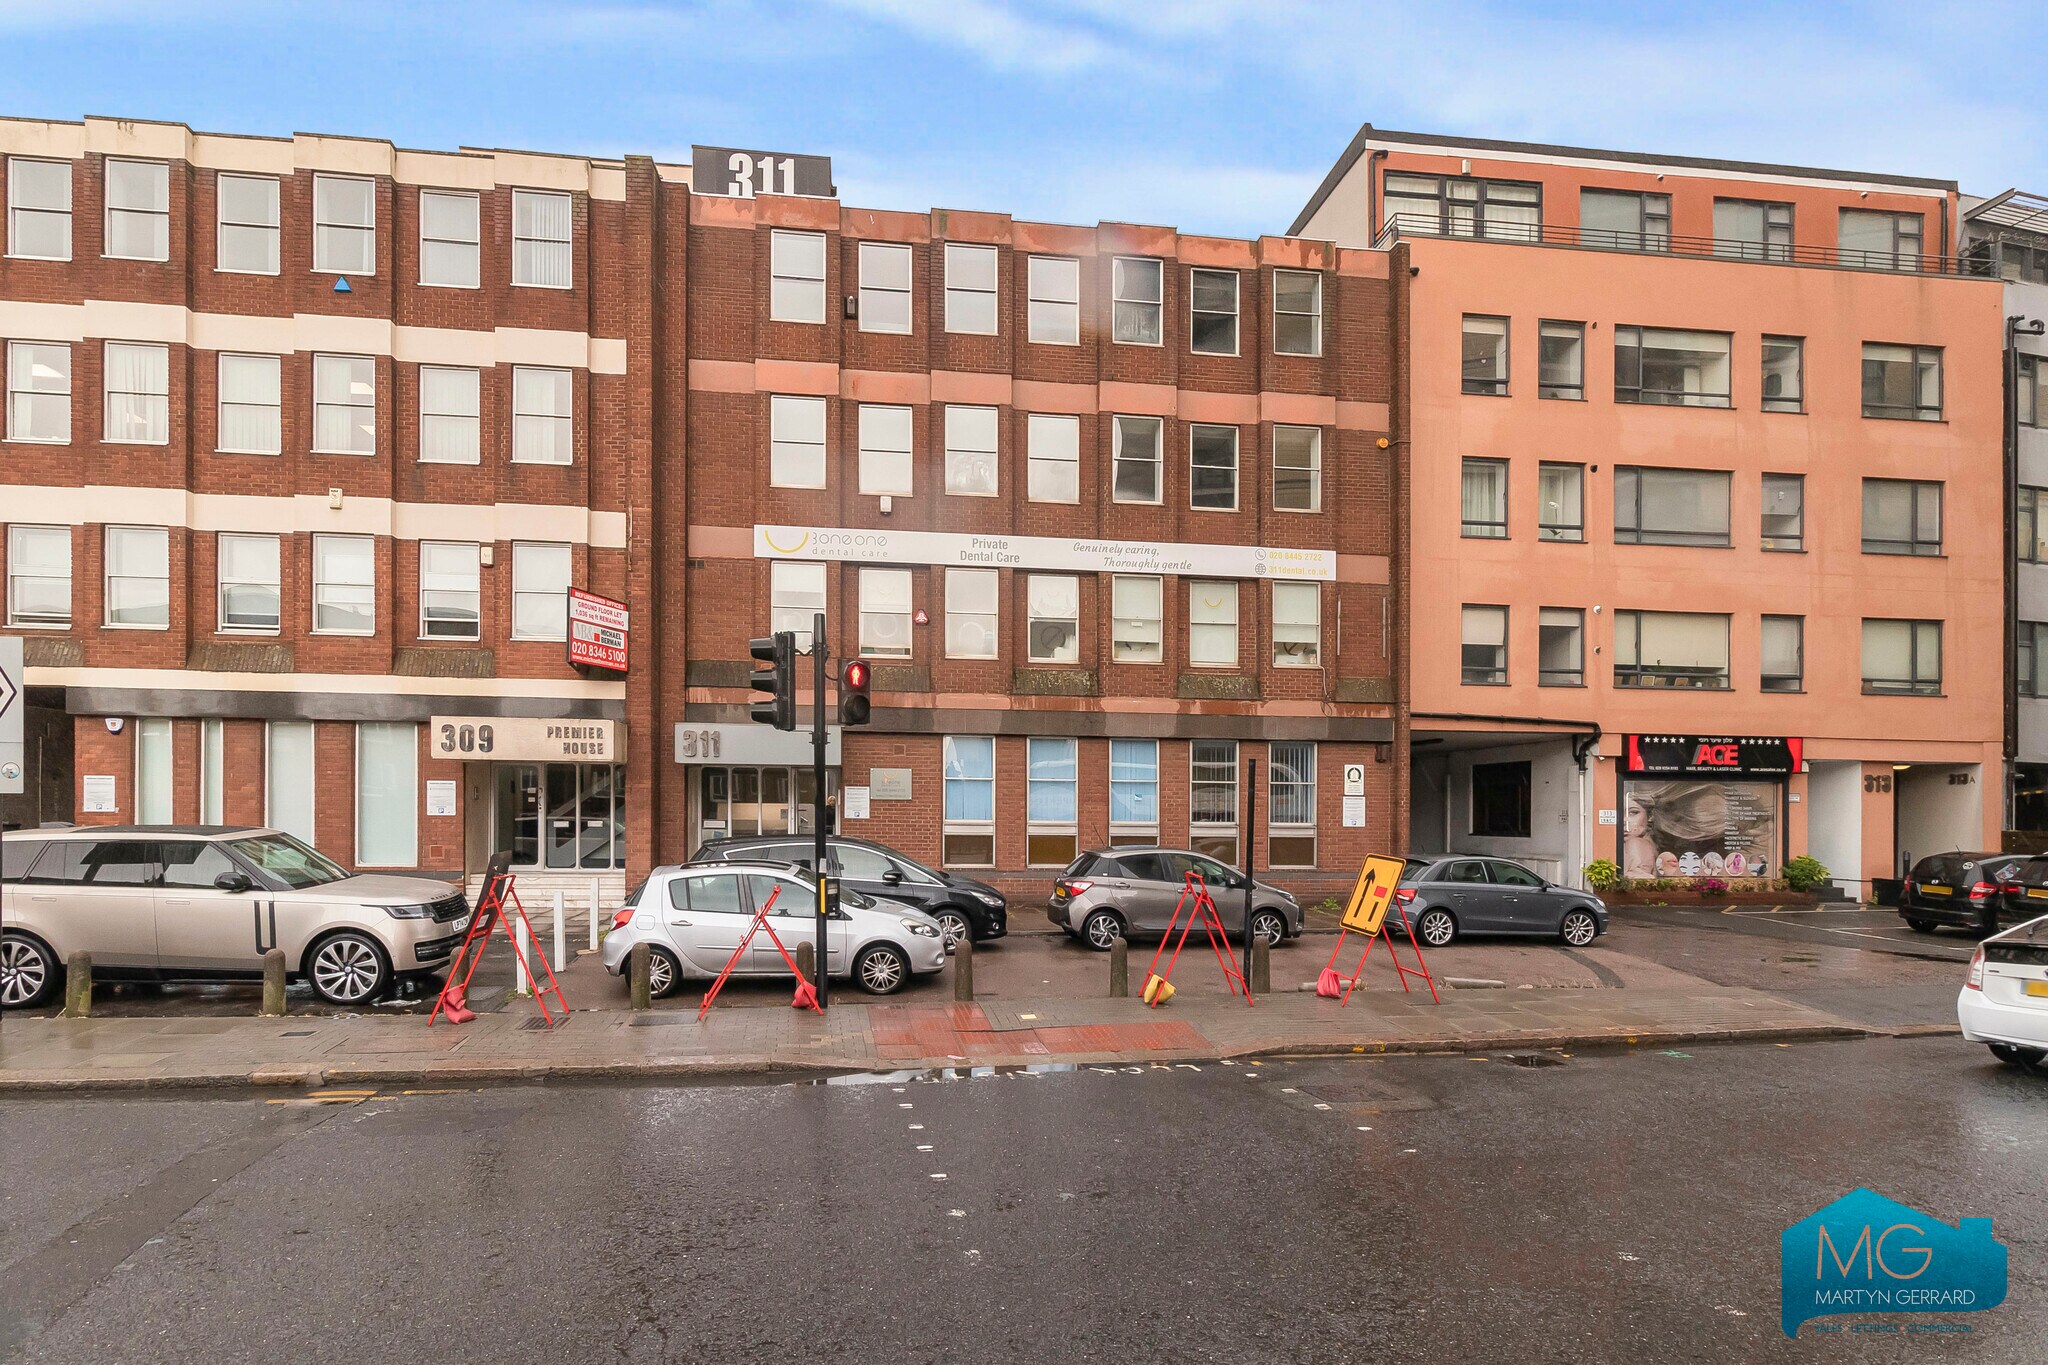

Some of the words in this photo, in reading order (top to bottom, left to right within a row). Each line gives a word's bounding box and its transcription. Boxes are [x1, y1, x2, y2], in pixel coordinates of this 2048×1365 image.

[728, 152, 795, 197] 311
[972, 538, 1008, 550] Private
[1073, 541, 1123, 556] Genuinely
[1125, 545, 1160, 557] caring,
[812, 547, 854, 556] dental
[960, 550, 993, 562] Dental
[996, 552, 1020, 563] Care
[1269, 551, 1283, 559] 020
[1305, 553, 1322, 561] 2722
[1103, 557, 1160, 571] Thoroughly
[1161, 560, 1192, 571] gentle
[577, 601, 598, 612] GROUND
[598, 606, 613, 616] FLOOR
[613, 610, 622, 618] LET
[599, 615, 625, 627] REMAINING
[600, 628, 622, 640] MICHAEL
[600, 636, 622, 648] BERMAN
[572, 641, 587, 655] 020
[588, 645, 607, 659] 8346
[608, 649, 626, 663] 5100
[440, 723, 494, 753] 309
[547, 725, 605, 740] PREMIER
[562, 742, 604, 755] HOUSE
[682, 729, 721, 757] 311
[1692, 744, 1739, 766] ACE
[1863, 774, 1892, 793] 313
